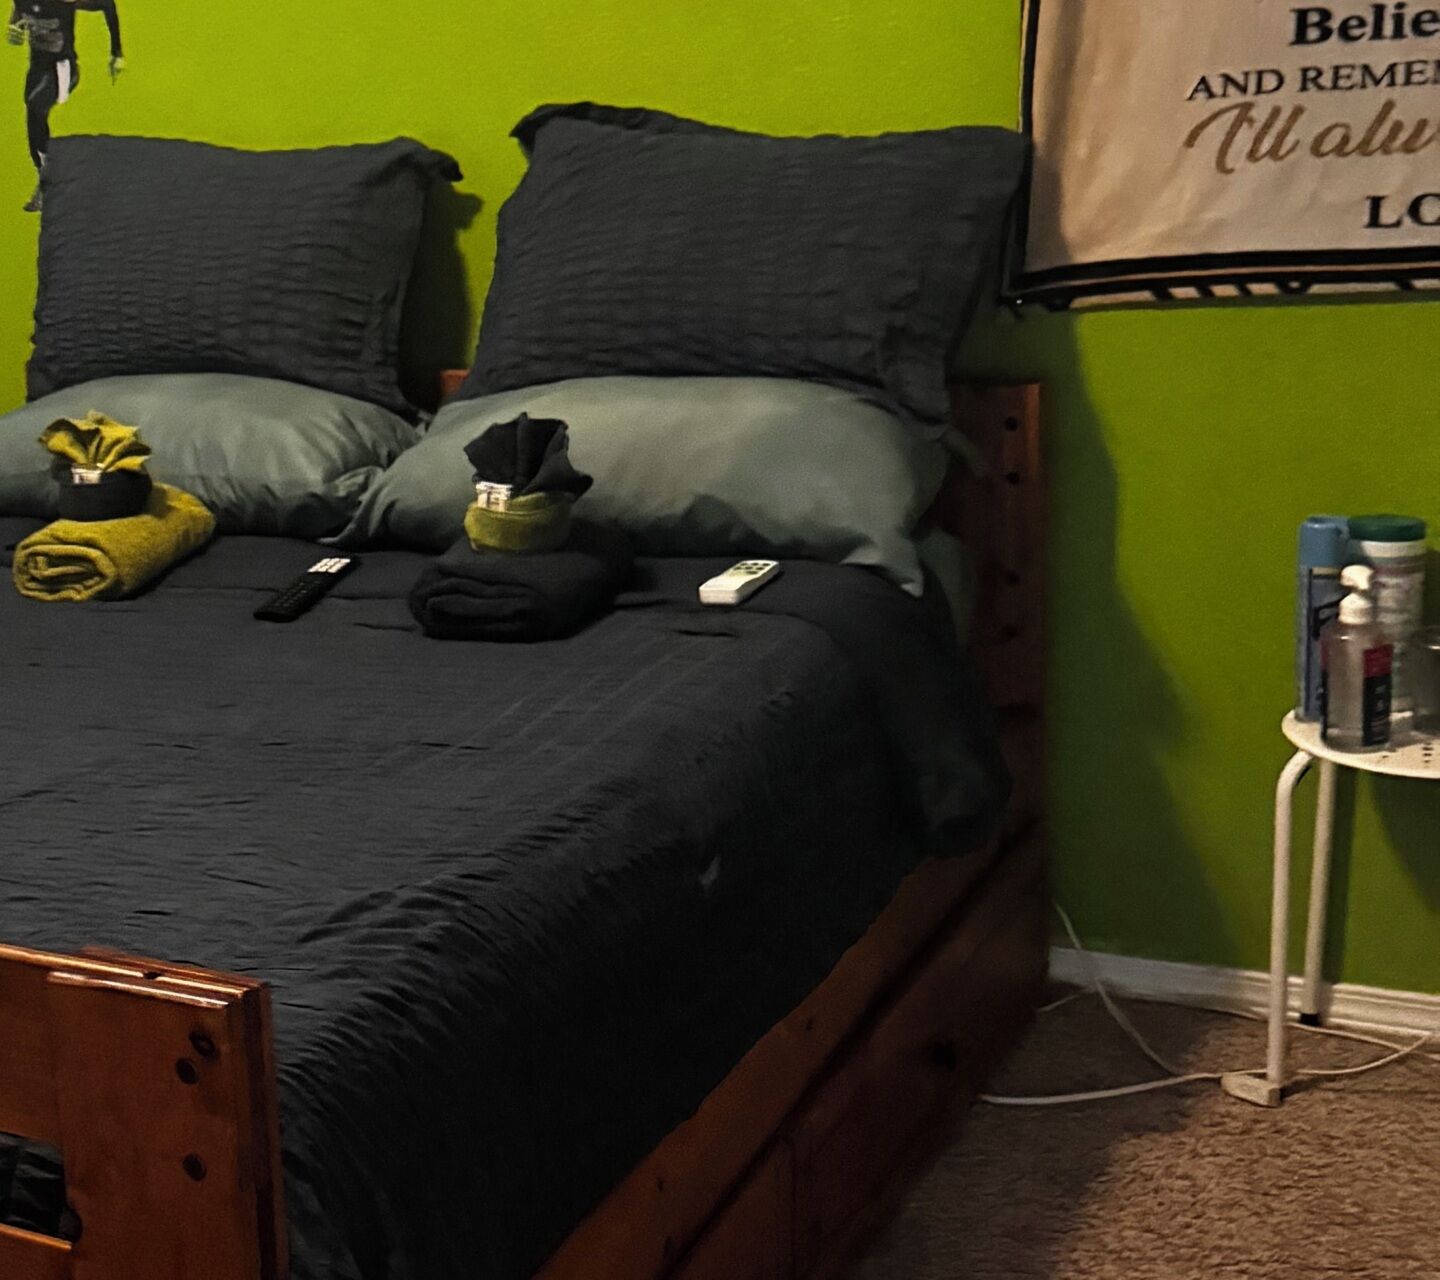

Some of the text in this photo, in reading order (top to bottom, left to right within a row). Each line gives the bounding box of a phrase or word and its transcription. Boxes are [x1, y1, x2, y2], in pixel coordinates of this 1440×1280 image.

[1289, 1, 1440, 46] Belie
[1185, 59, 1440, 102] AND REME
